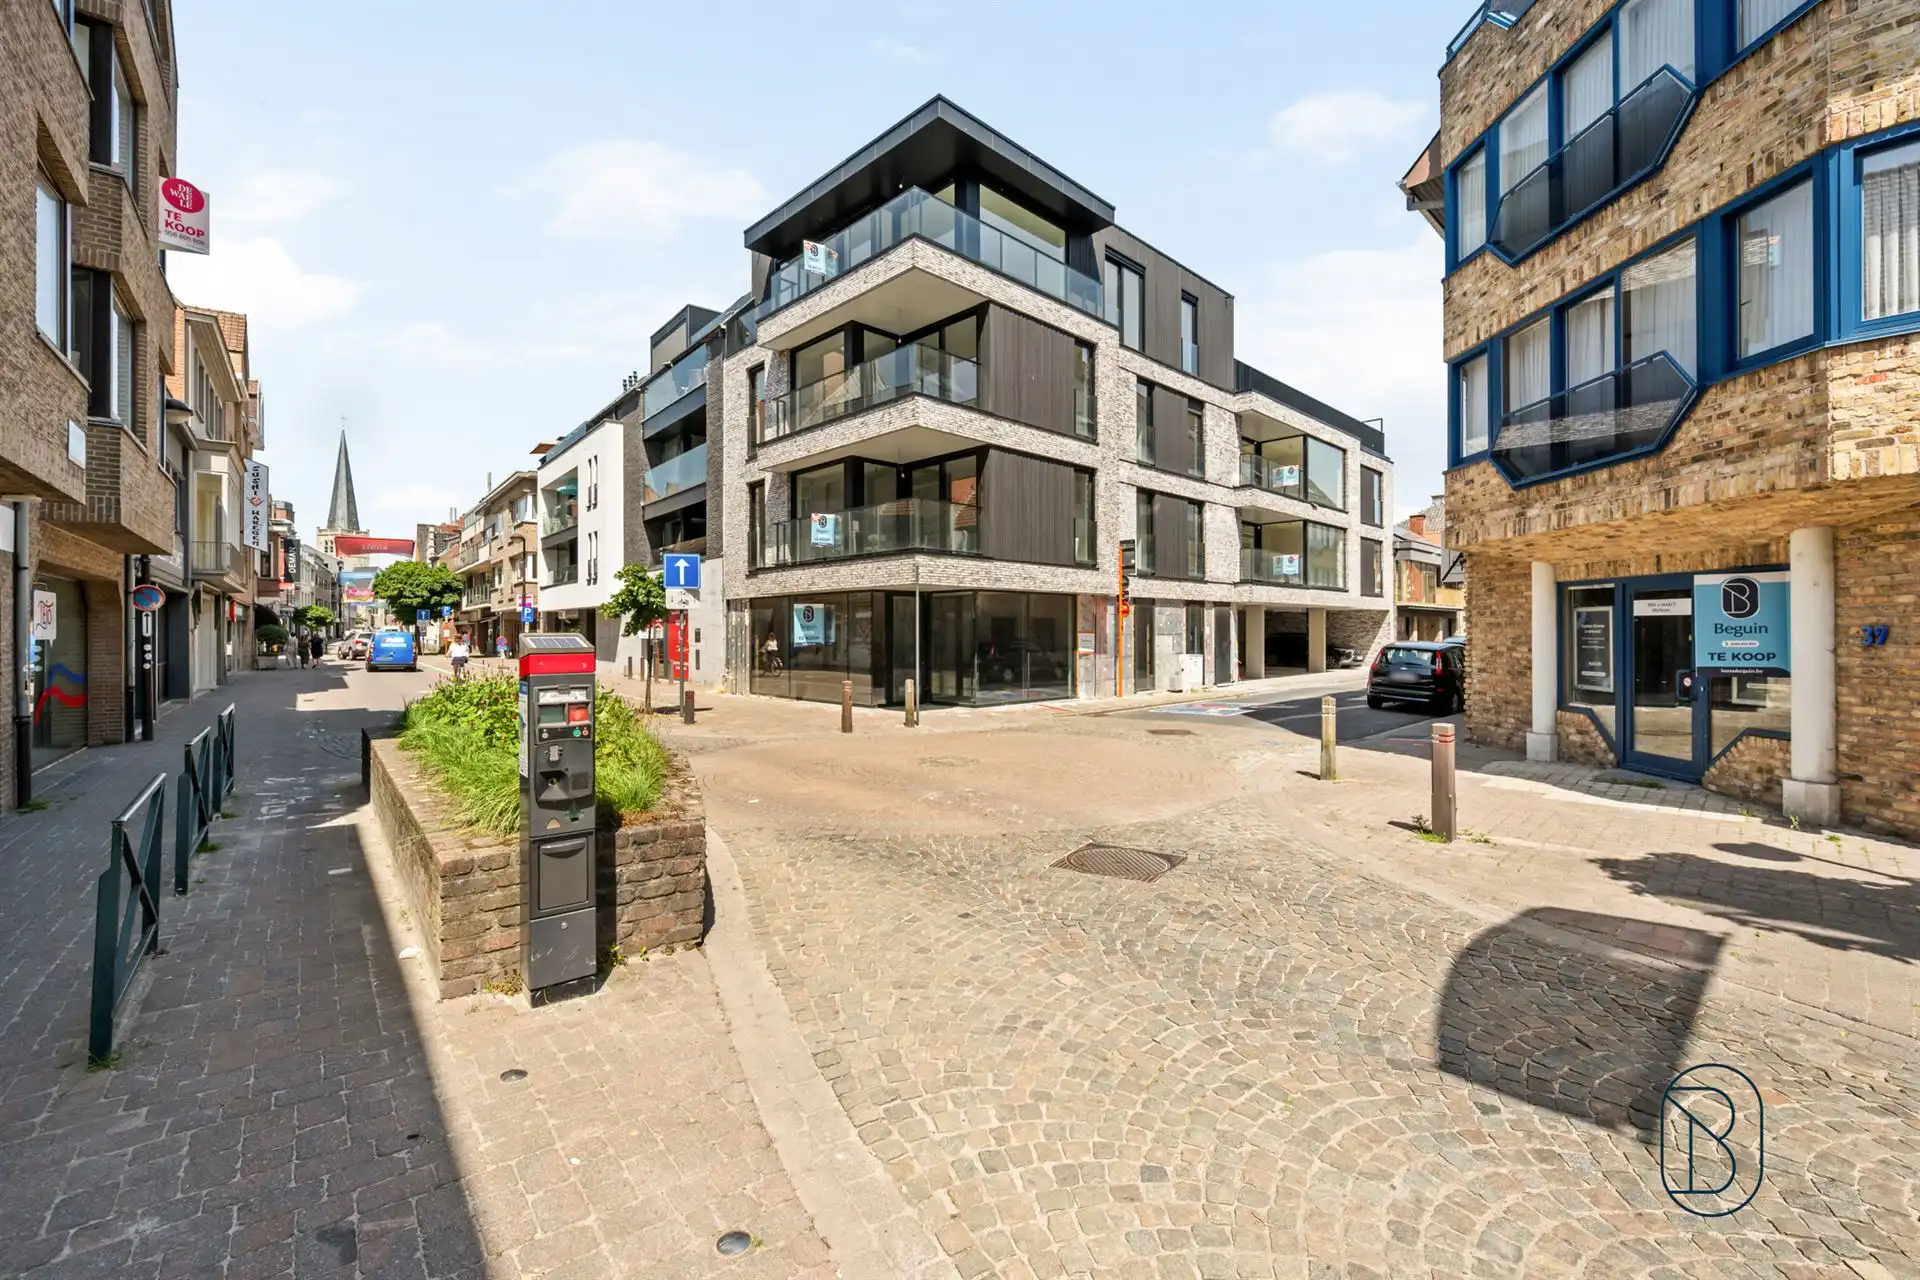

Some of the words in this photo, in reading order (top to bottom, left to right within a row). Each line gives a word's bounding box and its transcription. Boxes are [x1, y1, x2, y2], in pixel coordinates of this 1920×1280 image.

[178, 184, 192, 194] DE
[180, 199, 192, 210] LE
[164, 208, 182, 222] TE
[165, 220, 205, 237] KOOP
[1714, 622, 1769, 638] Beguin
[1708, 651, 1727, 662] TE
[1731, 651, 1777, 662] KOOP
